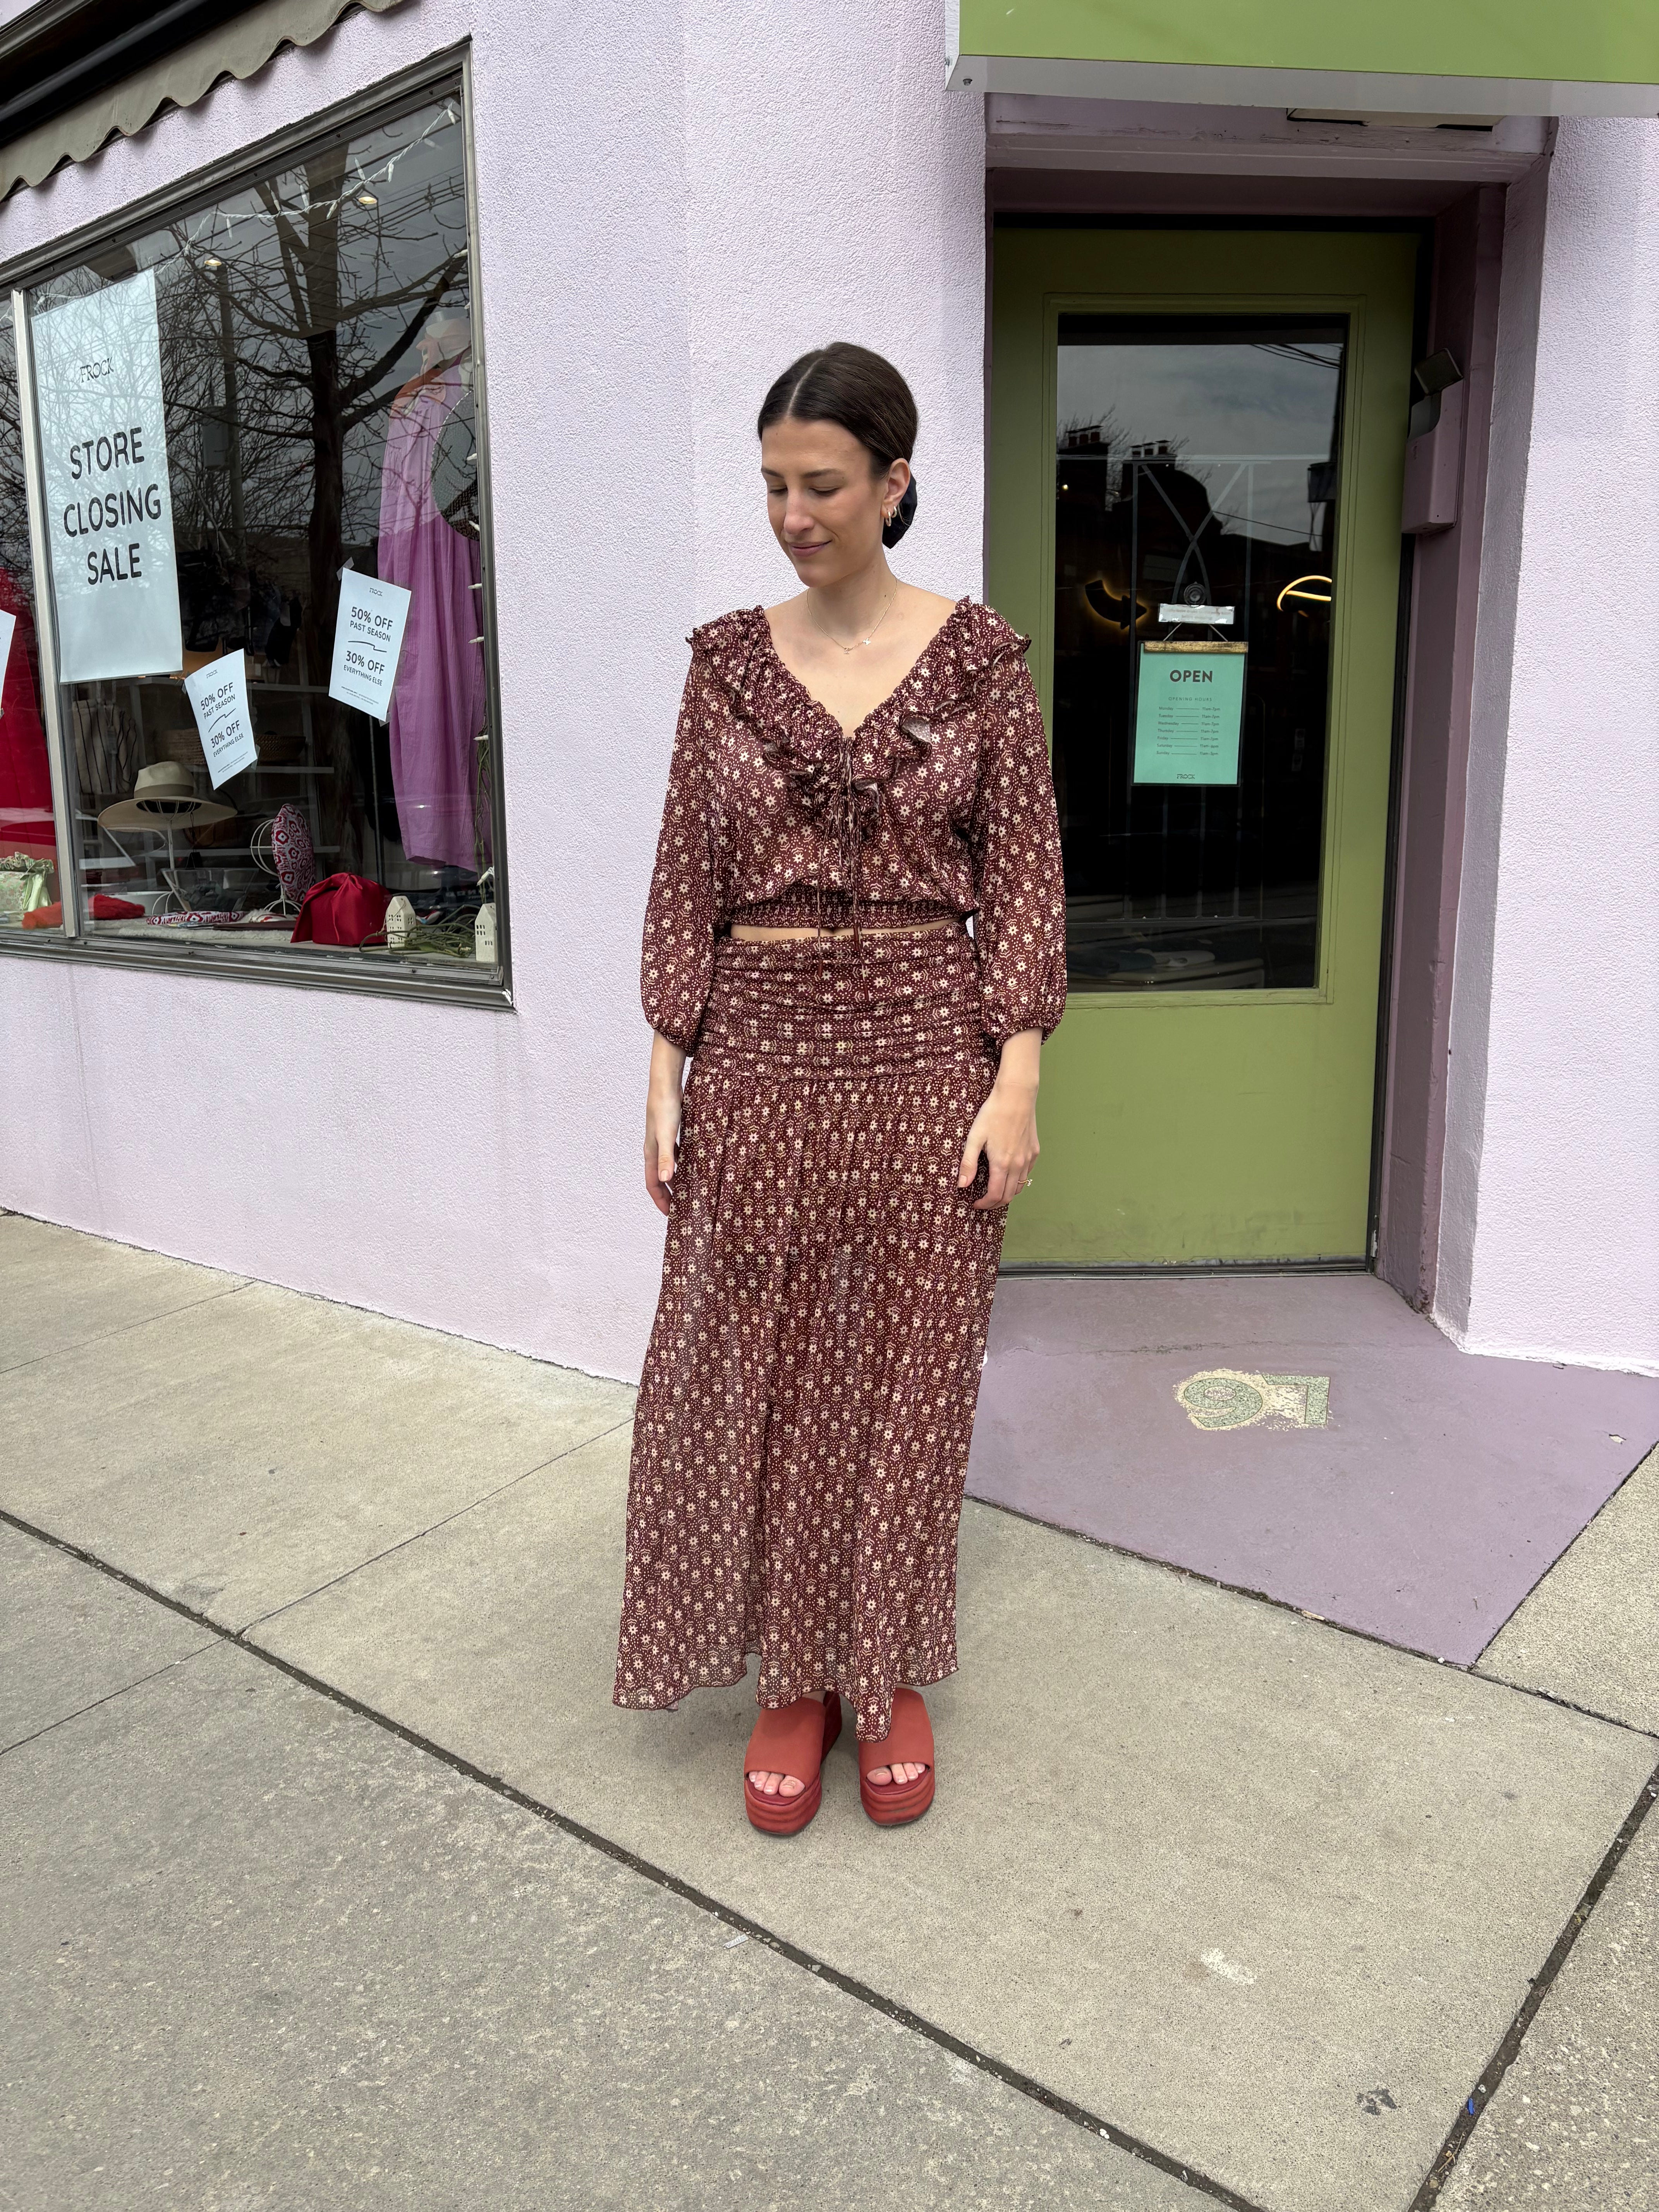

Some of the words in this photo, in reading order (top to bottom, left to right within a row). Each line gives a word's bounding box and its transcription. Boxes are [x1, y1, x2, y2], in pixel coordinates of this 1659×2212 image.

[80, 356, 114, 383] FROCK
[70, 427, 144, 479] STORE
[64, 484, 161, 537] CLOSING
[88, 543, 142, 585] SALE
[351, 606, 371, 623] 50%
[374, 615, 393, 630] OFF
[350, 620, 366, 632] PAST
[367, 627, 391, 642] SEASON
[346, 650, 364, 667] 30%
[368, 659, 385, 675] OFF
[343, 665, 371, 681] EVERYTHING
[372, 677, 383, 686] ELSE
[1170, 670, 1212, 683] OPEN
[201, 693, 216, 710] 50%
[217, 682, 233, 698] OFF
[203, 707, 214, 719] PAST
[215, 694, 235, 711] SEASON
[210, 731, 225, 748] 30%
[226, 720, 240, 737] OFF
[213, 739, 235, 757] EVERYTHING
[234, 732, 244, 742] ELSE
